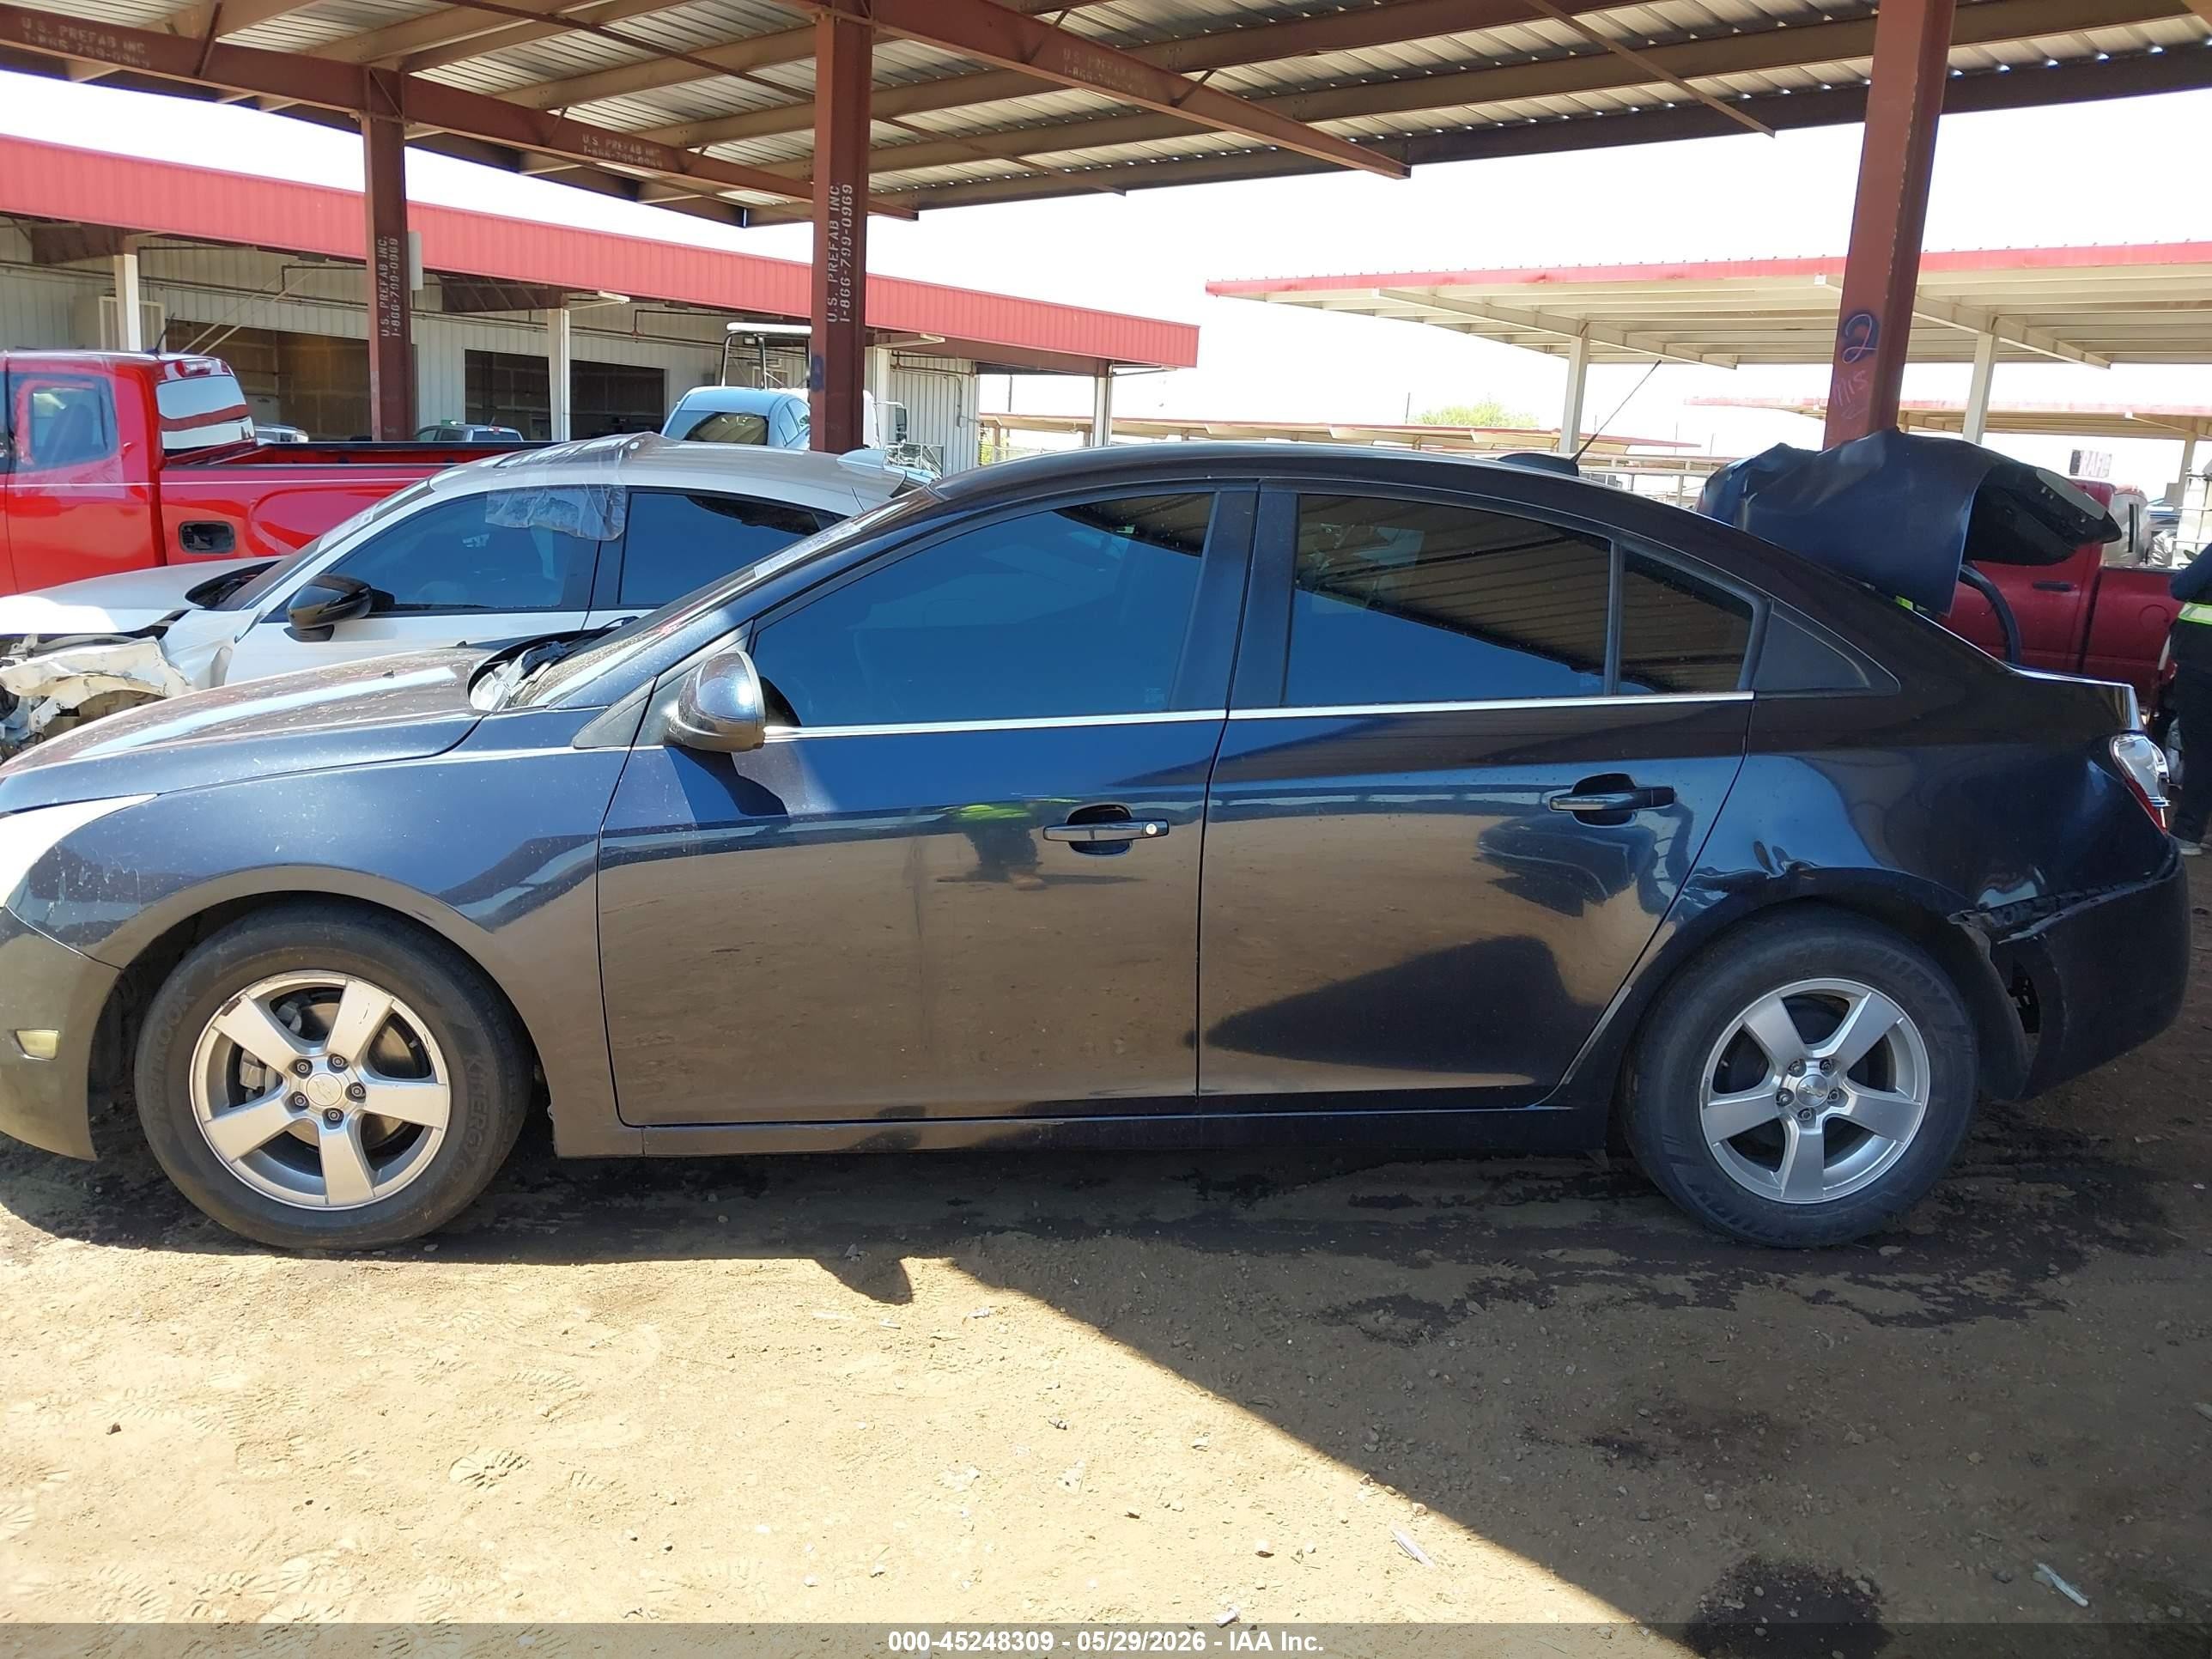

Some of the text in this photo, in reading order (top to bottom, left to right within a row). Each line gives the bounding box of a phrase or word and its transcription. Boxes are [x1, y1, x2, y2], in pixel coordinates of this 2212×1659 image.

[58, 24, 117, 49] PREFAB
[827, 220, 840, 283] PREFAB
[840, 184, 854, 323] 1-866-799-0969
[378, 264, 389, 310] PREFAB
[827, 292, 839, 323] U.S.
[1841, 312, 1879, 364] 2
